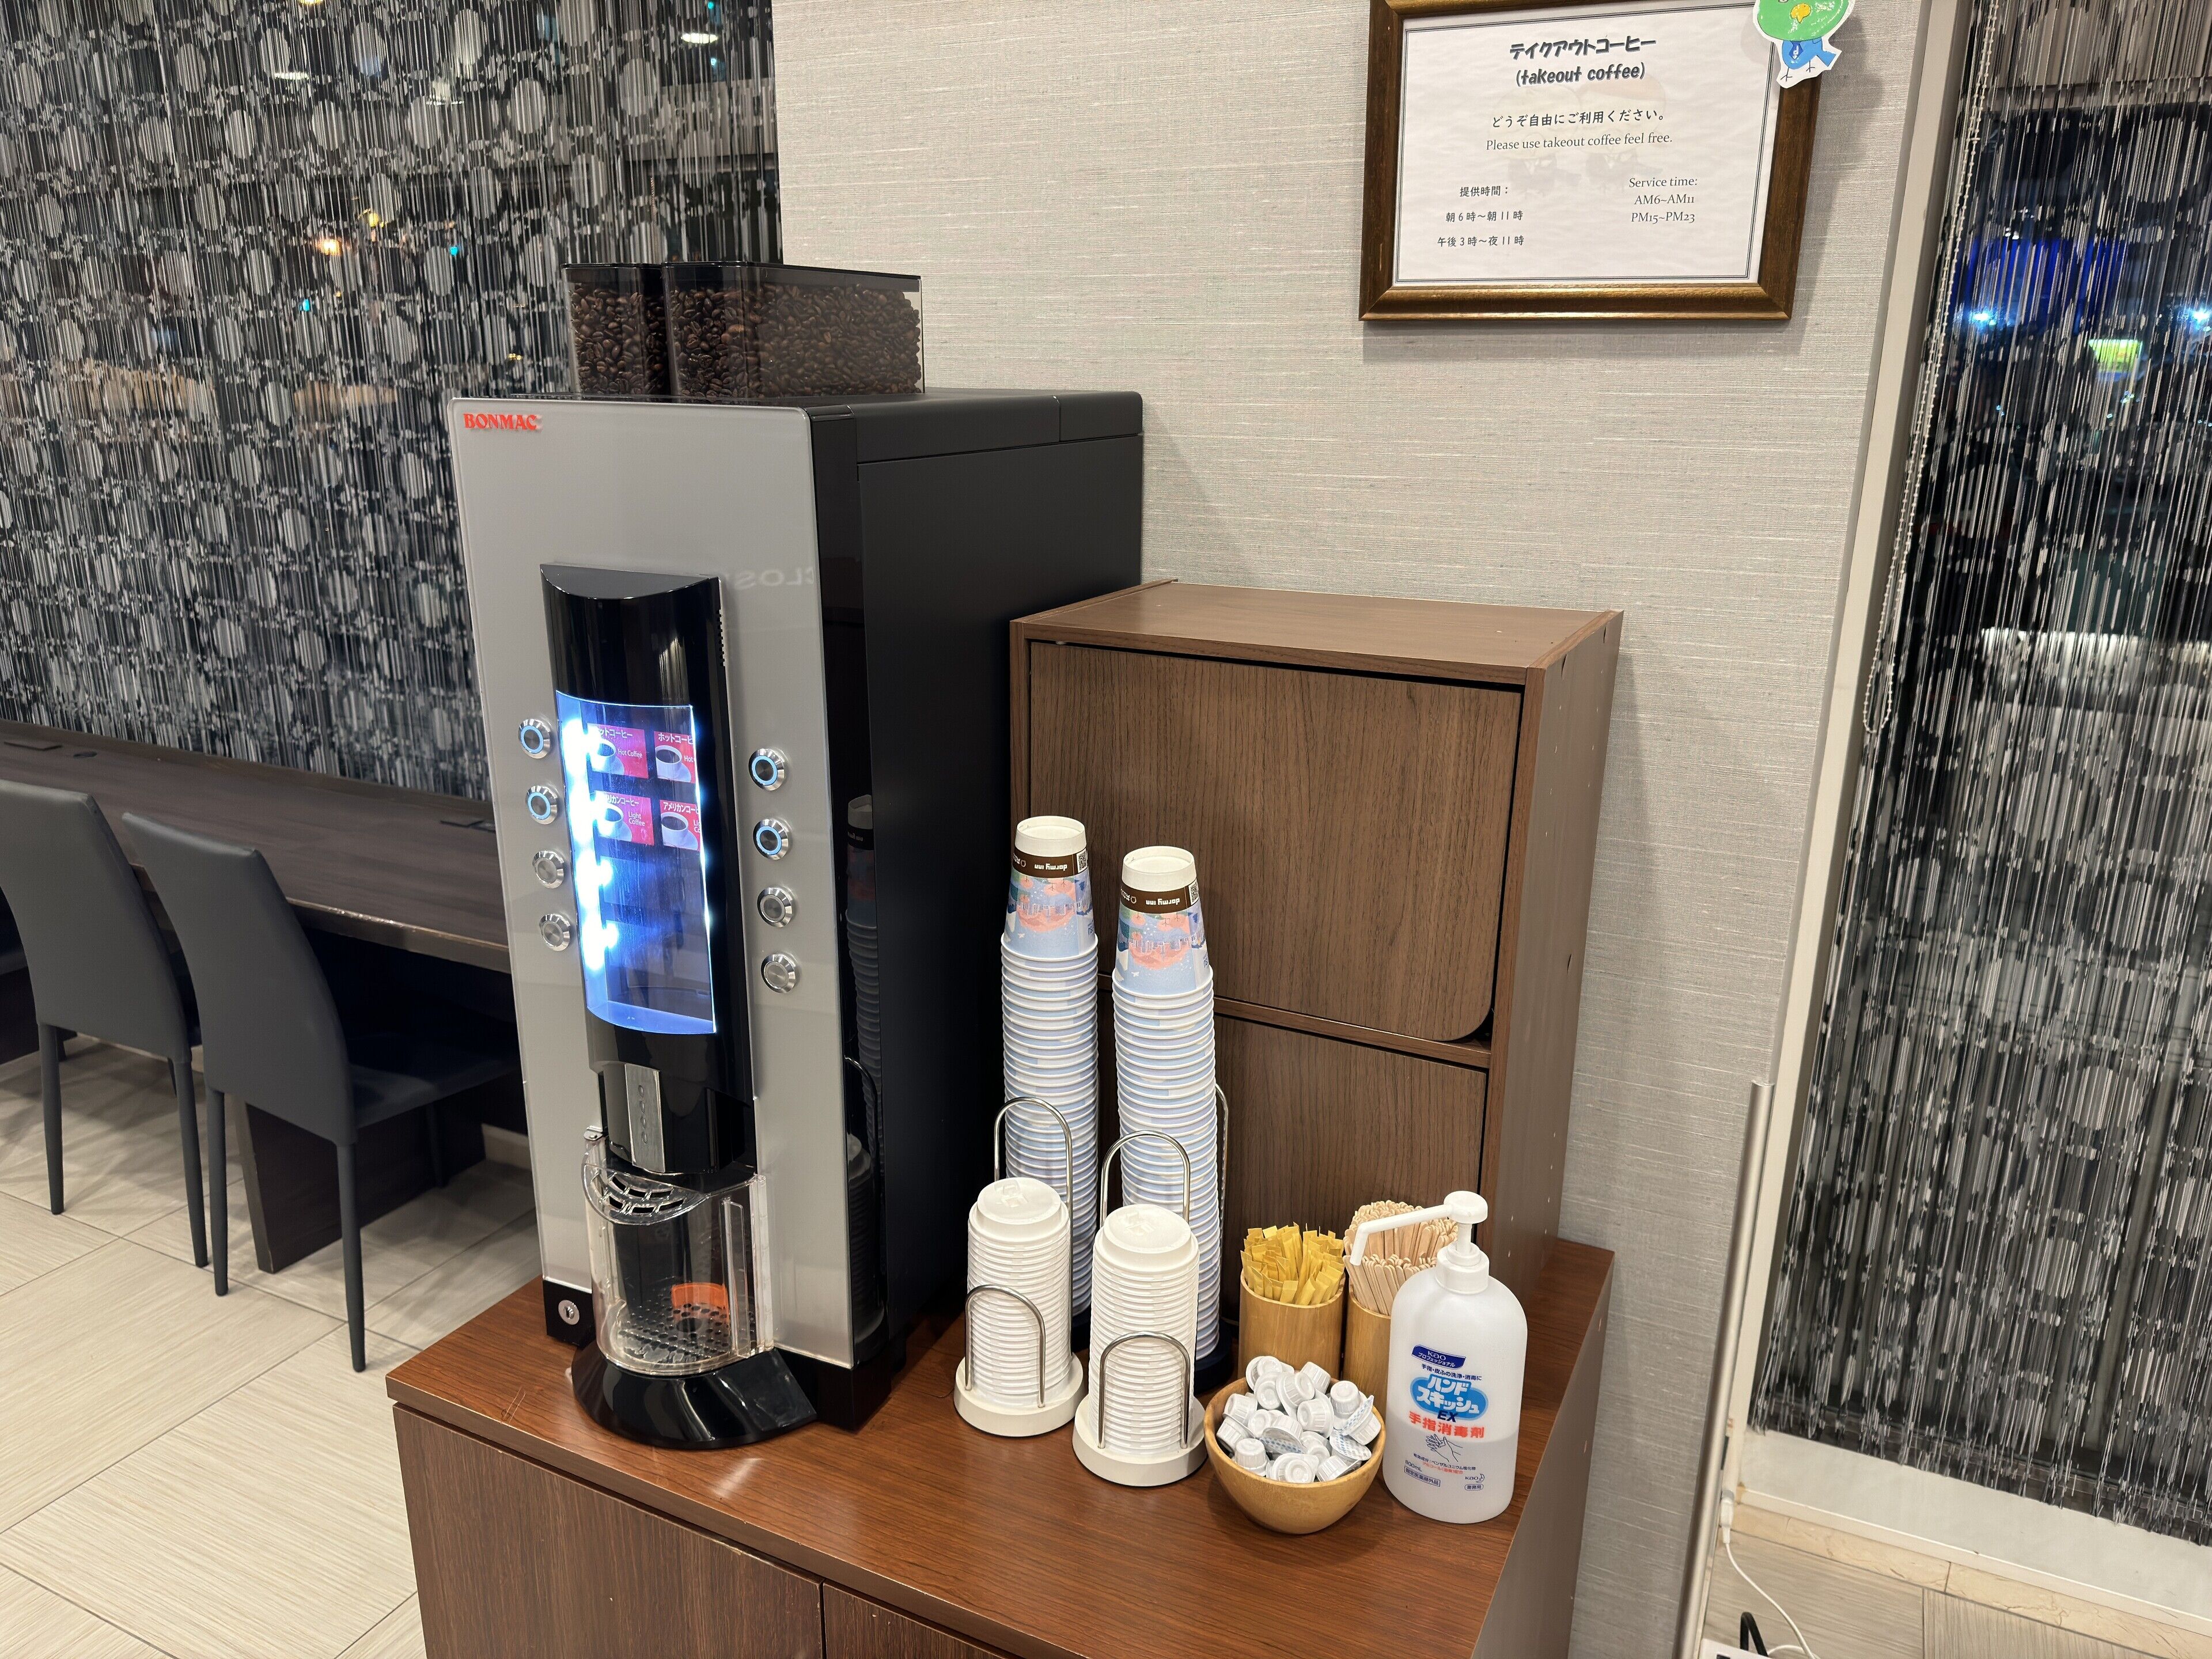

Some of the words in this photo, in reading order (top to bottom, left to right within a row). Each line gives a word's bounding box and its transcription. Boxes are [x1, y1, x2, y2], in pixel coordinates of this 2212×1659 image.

[1510, 35, 1657, 60] テイクアウトコーヒー
[1516, 66, 1582, 86] (takeout
[1588, 62, 1645, 81] coffee)
[1493, 109, 1664, 128] どうぞ自由にご利用ください。
[1486, 139, 1520, 151] Please
[1522, 139, 1540, 149] use
[1543, 136, 1585, 148] takeout
[1588, 134, 1621, 146] coffee
[1624, 132, 1644, 145] feel
[1647, 131, 1673, 143] free.
[1629, 177, 1667, 188] Service
[1670, 176, 1698, 186] time:
[1459, 185, 1508, 197] 提供時間：
[1634, 194, 1695, 205] AM6~AM11
[1631, 211, 1695, 225] PM15~PM23
[463, 413, 537, 430] BONMAC
[599, 726, 633, 738] ットコーヒー
[658, 732, 694, 745] ホットコーヒ
[627, 749, 643, 758] Coffee
[684, 754, 694, 763] Hot
[607, 794, 639, 806] リカンコーヒー
[663, 801, 699, 815] アメリカンコーヒ
[628, 811, 642, 820] Light
[628, 818, 645, 827] Coffee
[1046, 863, 1067, 871] dormy
[1157, 897, 1180, 906] dormy
[1418, 1352, 1456, 1368] プロフェッショナル
[1421, 1363, 1482, 1381] 手指・皮ふの洗浄・消毒に
[1427, 1376, 1469, 1396] ハンド
[1416, 1385, 1480, 1414] スキッシュ
[1437, 1410, 1459, 1423] EX
[1409, 1411, 1485, 1439] 手指消毒剤
[1405, 1459, 1423, 1472] 800mL
